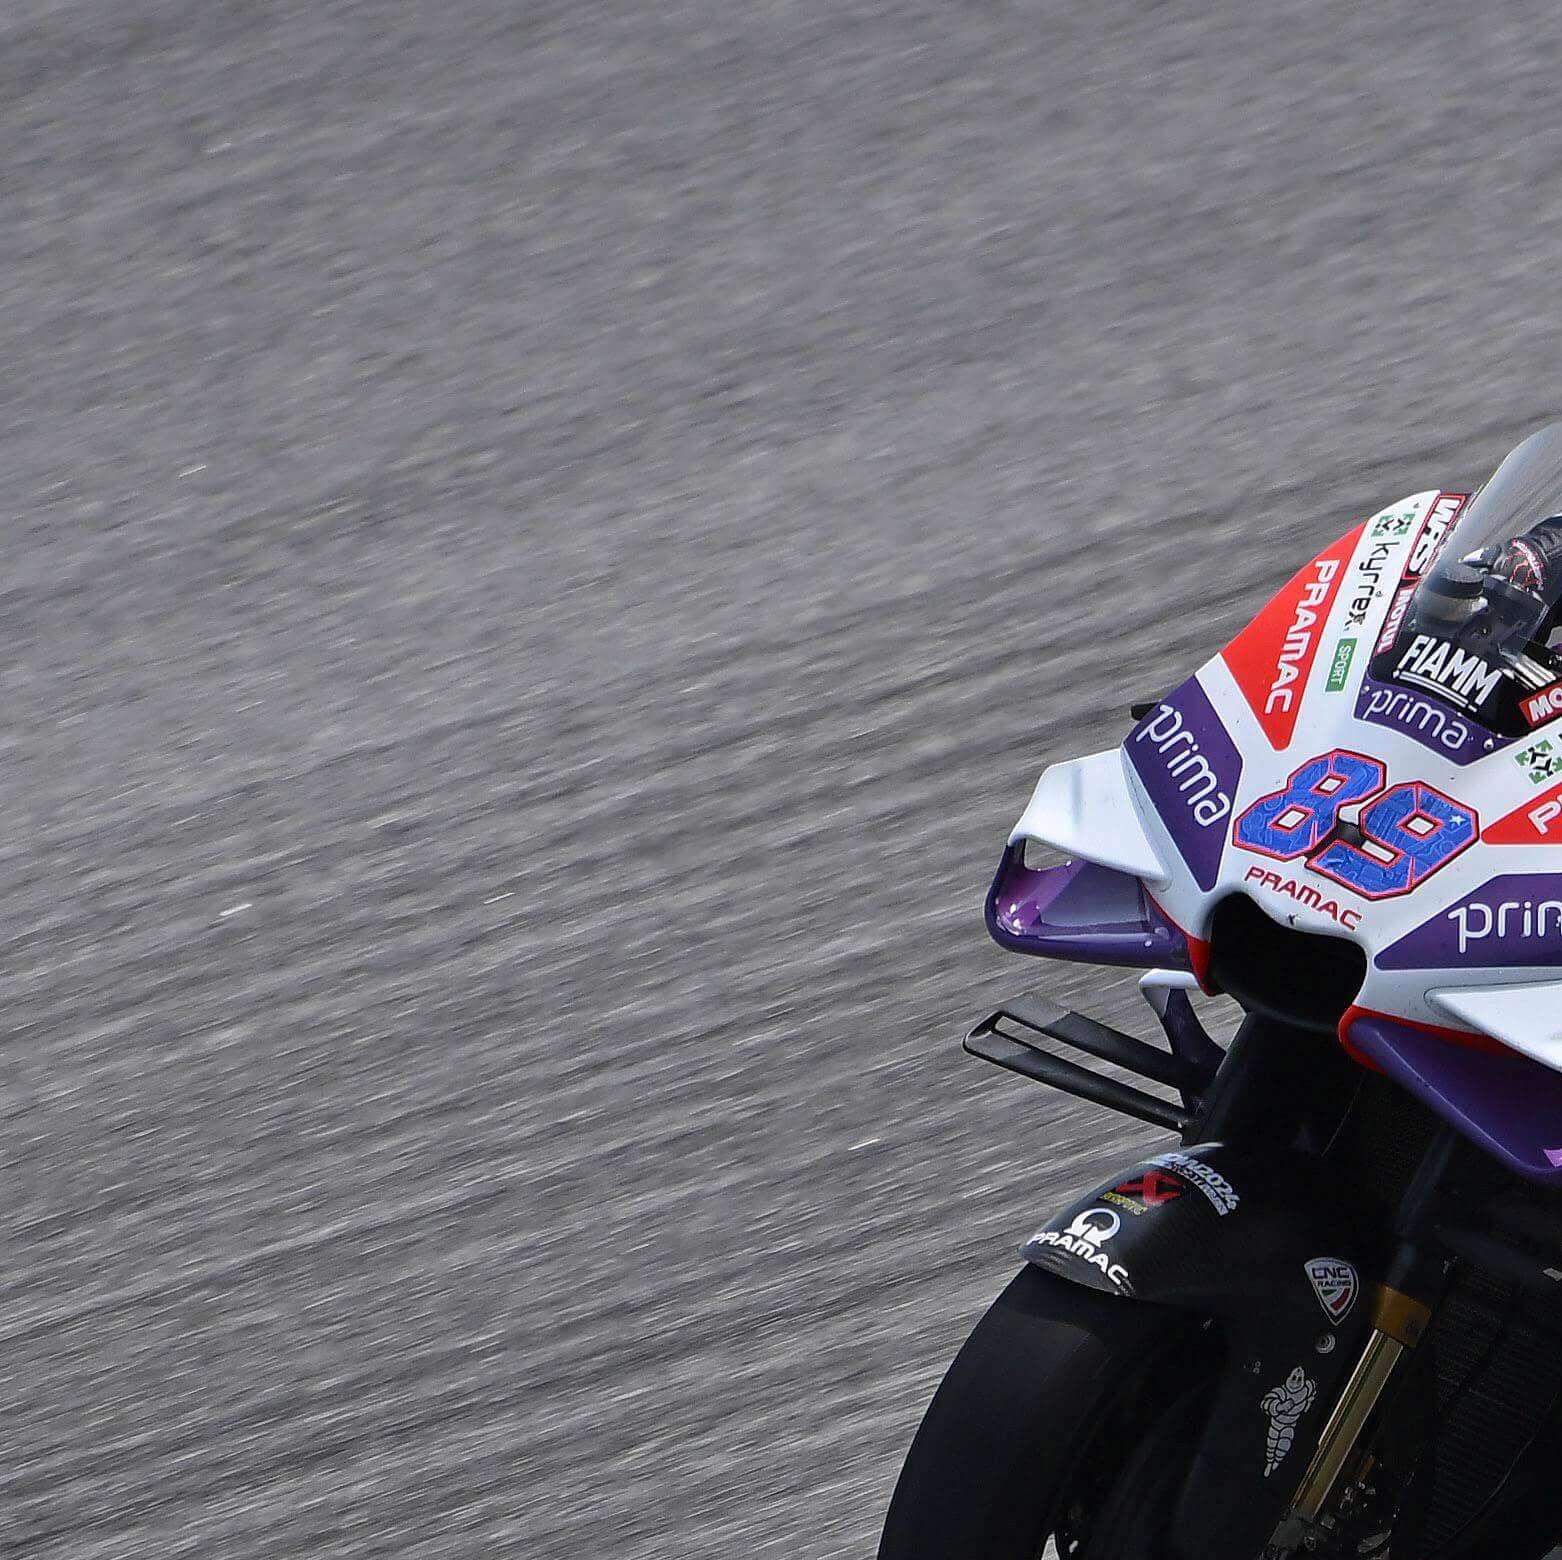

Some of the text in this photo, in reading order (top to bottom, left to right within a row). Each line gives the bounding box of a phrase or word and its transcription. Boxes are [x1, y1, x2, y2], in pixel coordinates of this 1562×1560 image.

[1345, 542, 1400, 626] kyrrex
[1265, 559, 1340, 715] PRAMAC
[1331, 645, 1351, 683] SPORT
[1398, 634, 1502, 706] FIAMM
[1367, 687, 1469, 750] prima
[1136, 704, 1231, 827] prima
[1232, 748, 1480, 901] 89
[1244, 866, 1363, 932] PRAMAC
[1026, 1232, 1129, 1285] PRAMAC
[1312, 1266, 1350, 1279] CNC
